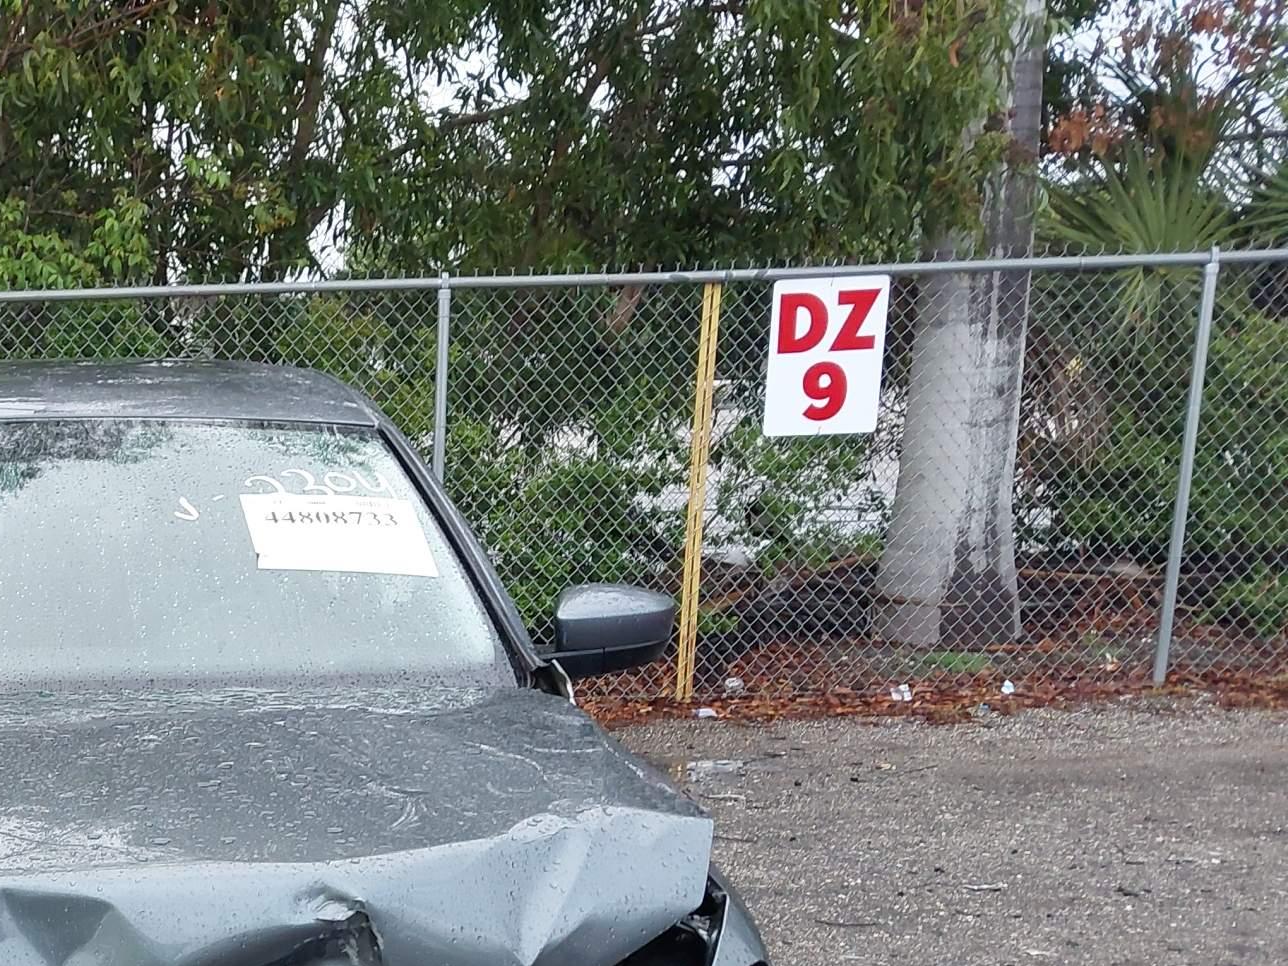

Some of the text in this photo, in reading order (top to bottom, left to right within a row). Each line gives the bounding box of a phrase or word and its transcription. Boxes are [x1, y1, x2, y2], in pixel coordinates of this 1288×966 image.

[777, 288, 882, 354] DZ
[802, 361, 847, 421] 9
[265, 511, 399, 526] 44808733
